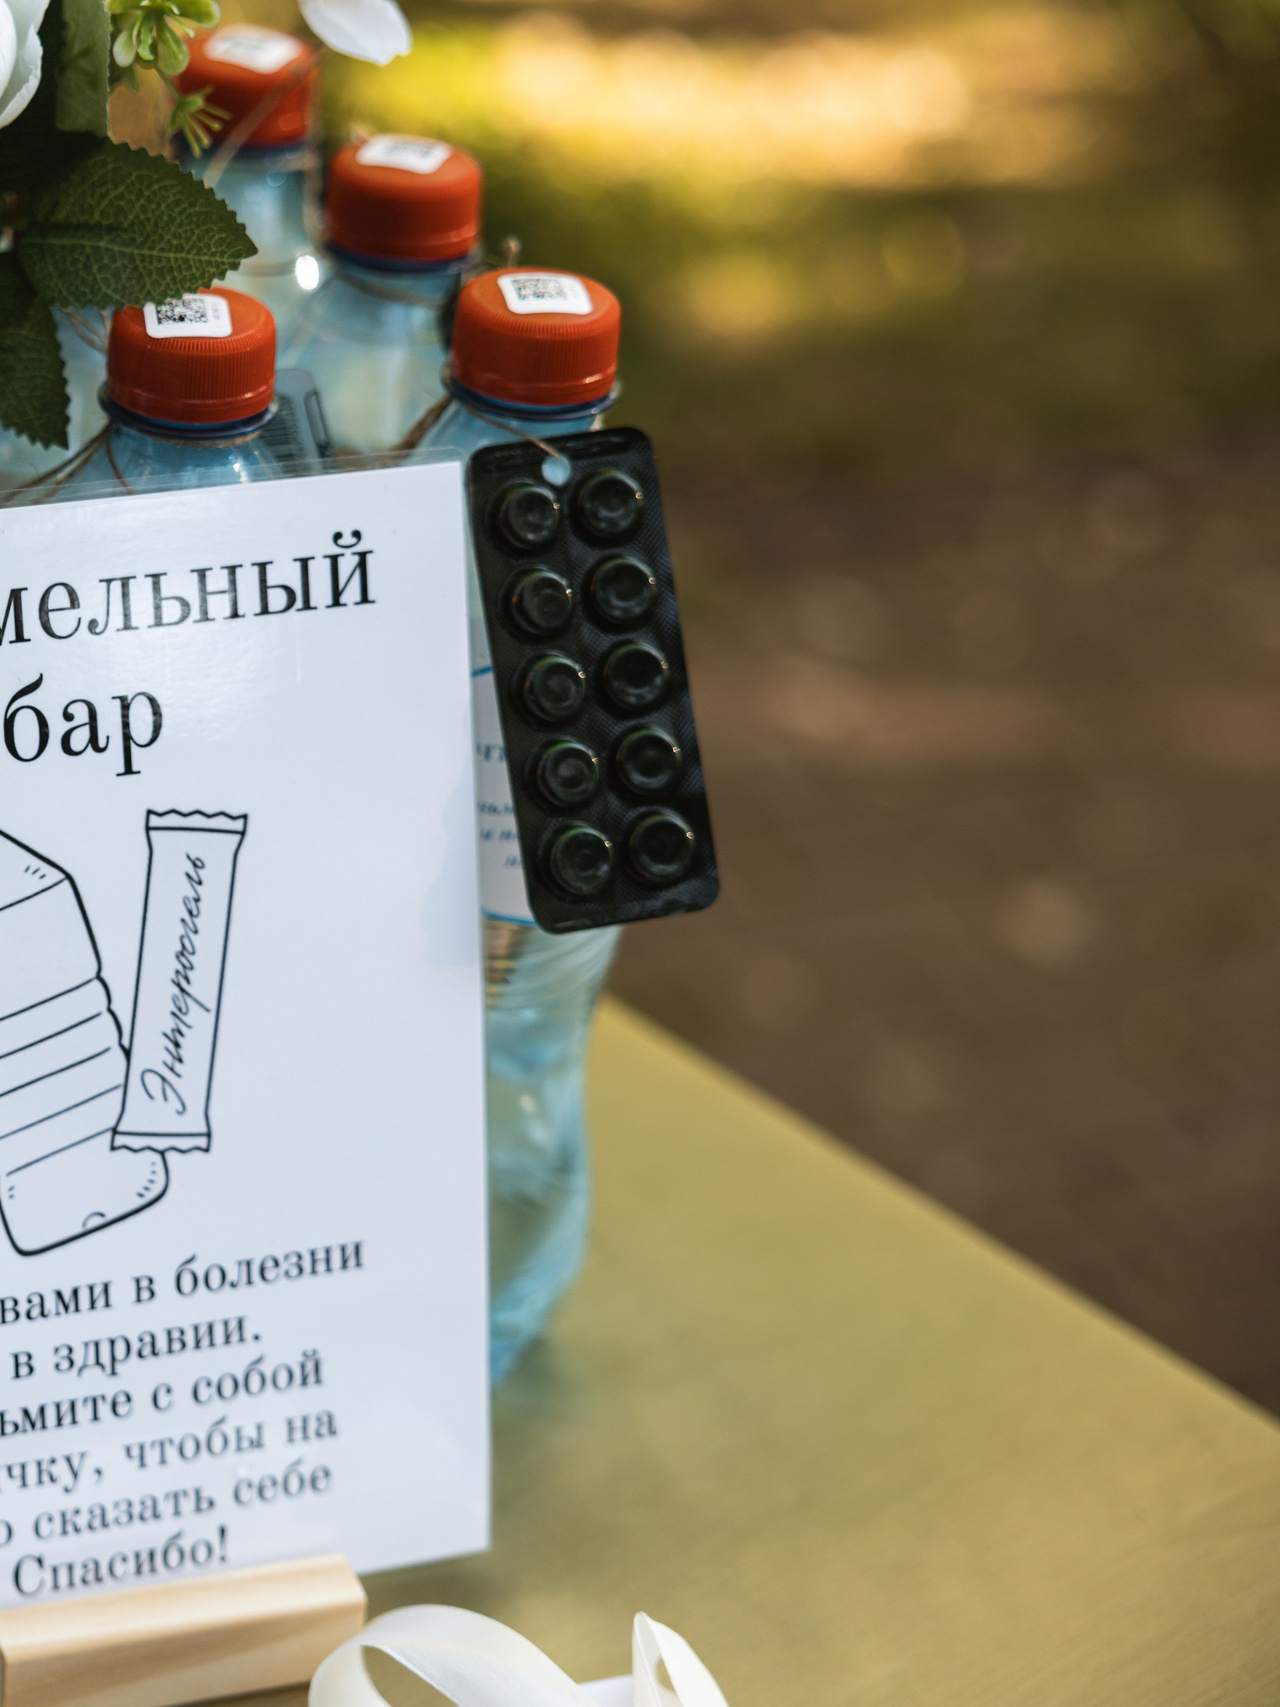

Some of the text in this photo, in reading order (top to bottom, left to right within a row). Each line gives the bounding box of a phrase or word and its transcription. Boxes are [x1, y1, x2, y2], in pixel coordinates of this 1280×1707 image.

[3, 673, 164, 778] бар
[132, 1274, 157, 1304] в
[174, 1239, 366, 1296] болезни
[11, 1350, 35, 1380] в
[53, 1315, 263, 1377] здравии.
[151, 1381, 173, 1412] с
[191, 1348, 326, 1405] собой
[123, 1415, 266, 1471] чтобы
[285, 1407, 339, 1444] на
[33, 1482, 217, 1540] сказать
[233, 1461, 333, 1508] себе
[12, 1523, 231, 1597] Спасибо!
